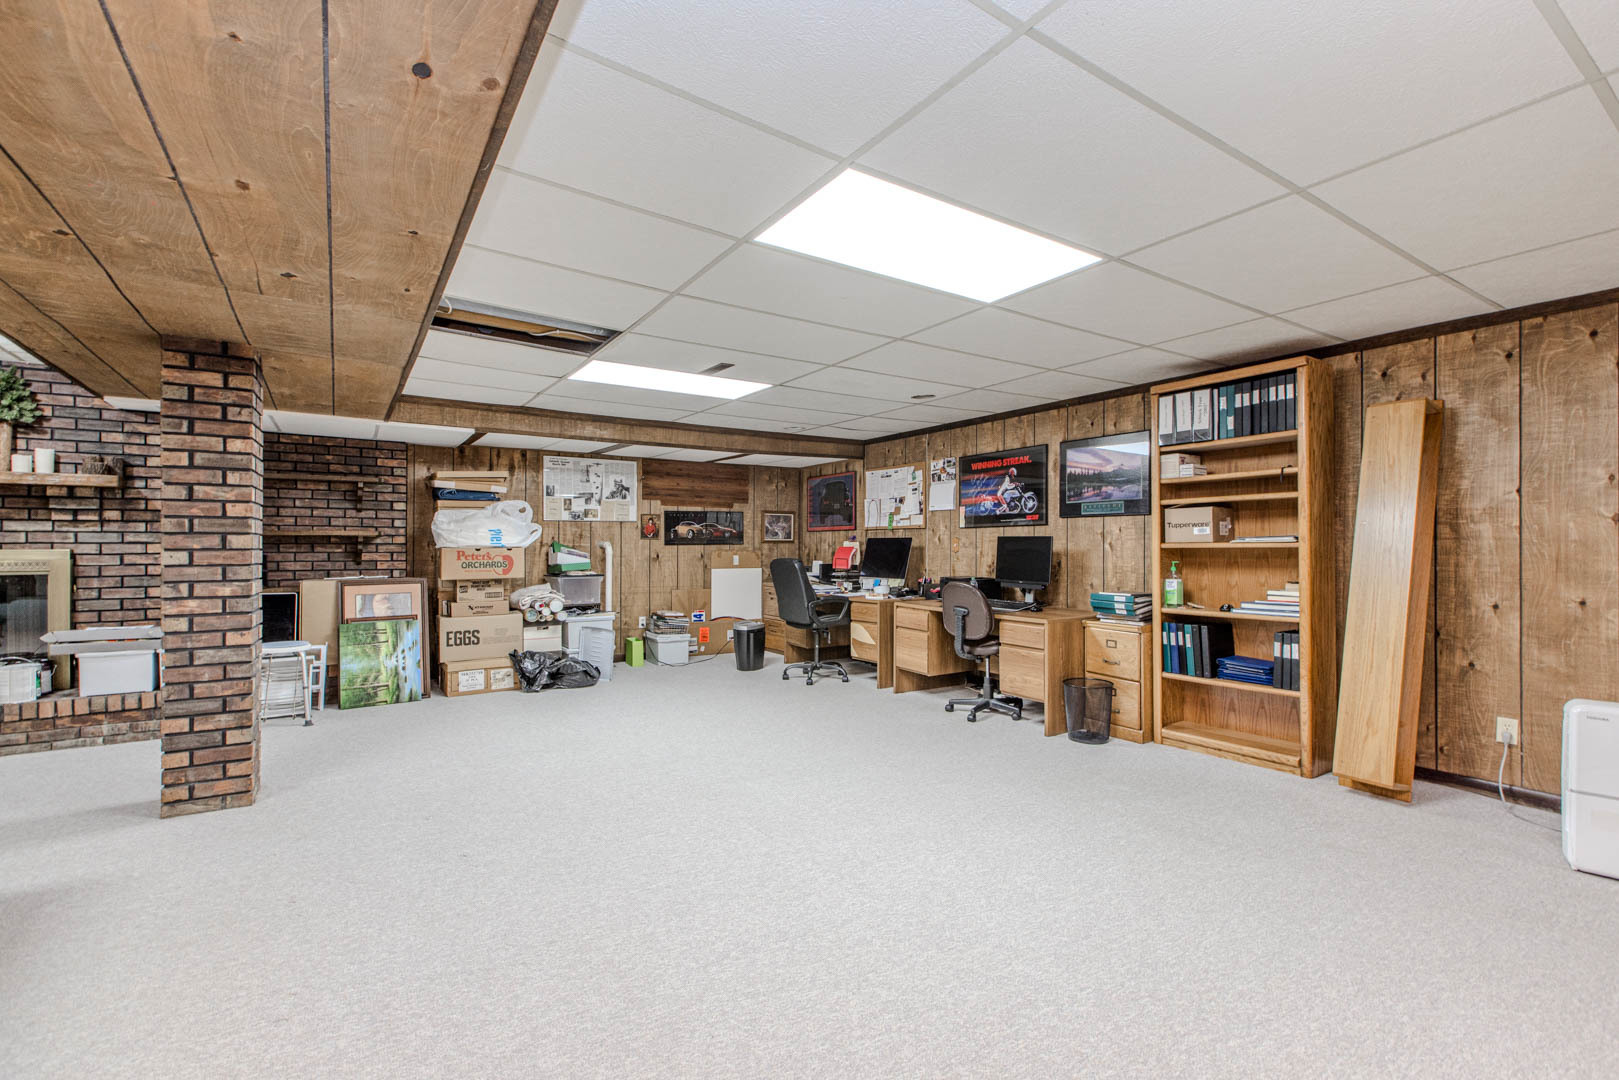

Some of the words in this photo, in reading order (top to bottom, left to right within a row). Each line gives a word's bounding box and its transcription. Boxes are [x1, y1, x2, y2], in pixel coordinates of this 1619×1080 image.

[971, 459, 1002, 471] WINNING
[1003, 455, 1032, 466] STREAK.
[461, 561, 508, 569] ORCHARDS
[446, 629, 480, 648] EGGS
